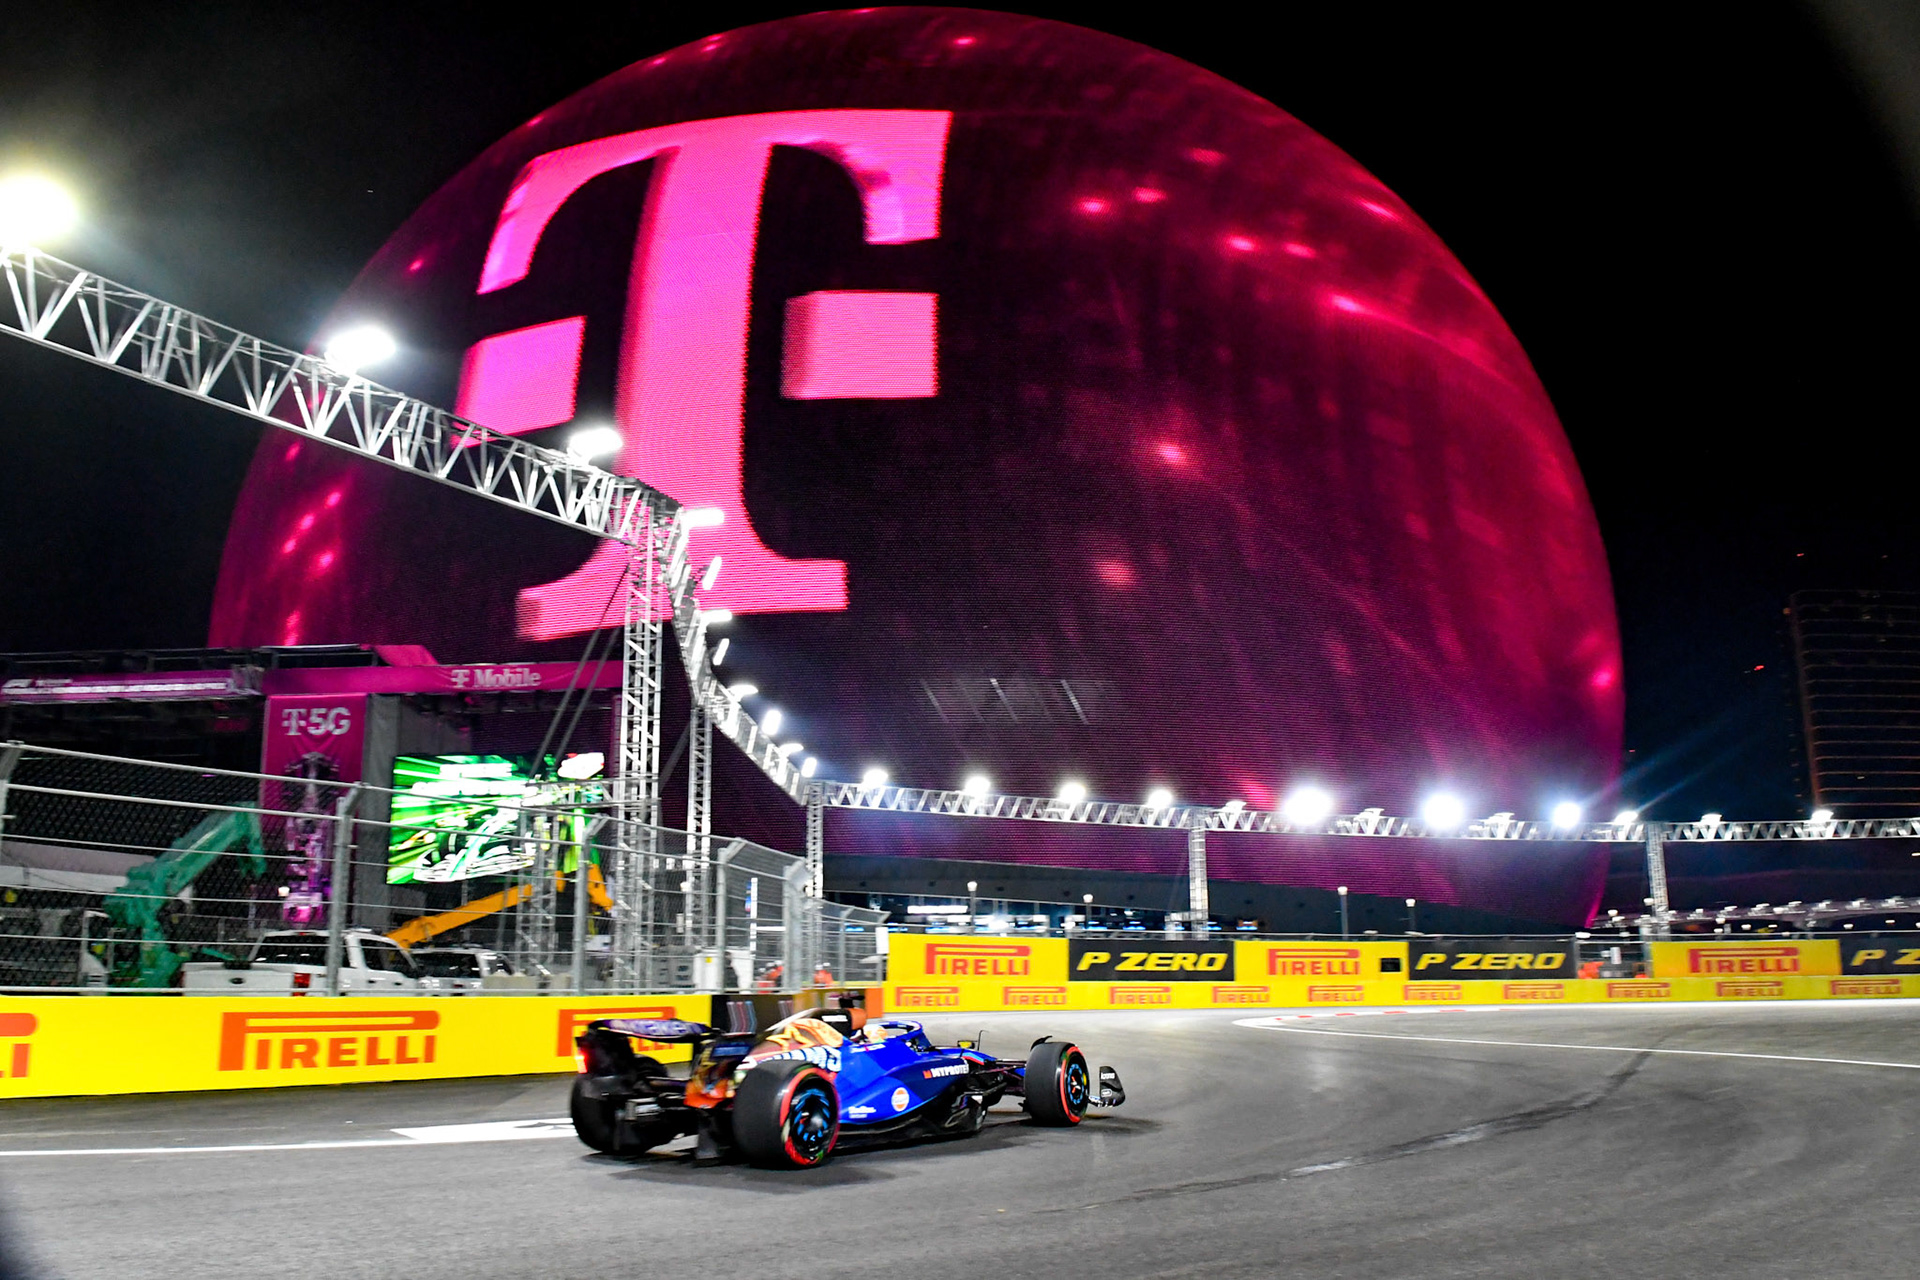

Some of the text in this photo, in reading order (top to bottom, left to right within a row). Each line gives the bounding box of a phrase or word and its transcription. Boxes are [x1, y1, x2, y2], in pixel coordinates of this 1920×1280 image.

[473, 668, 542, 688] Mobile
[307, 707, 352, 736] 5G
[925, 943, 1032, 976] PIRELLI
[1076, 952, 1229, 972] P ZERO
[1268, 948, 1361, 976] PIRELLI
[1415, 952, 1567, 971] P ZERO
[1689, 947, 1799, 973] PIRELLI
[1851, 949, 1887, 967] P
[895, 986, 959, 1006] PIRELLI
[1003, 986, 1067, 1006] PIRELLI
[1109, 986, 1171, 1005] PIRELLI
[1212, 985, 1270, 1003] PIRELLI
[1308, 985, 1365, 1002] PIRELLI
[1403, 984, 1462, 1001] PIRELLI
[1503, 983, 1564, 1000] PIRELLI
[1607, 982, 1670, 998] PIRELLI
[1716, 981, 1784, 997] PIRELLI
[1830, 979, 1901, 995] PIRELLI
[218, 1010, 441, 1072] PIRELLI
